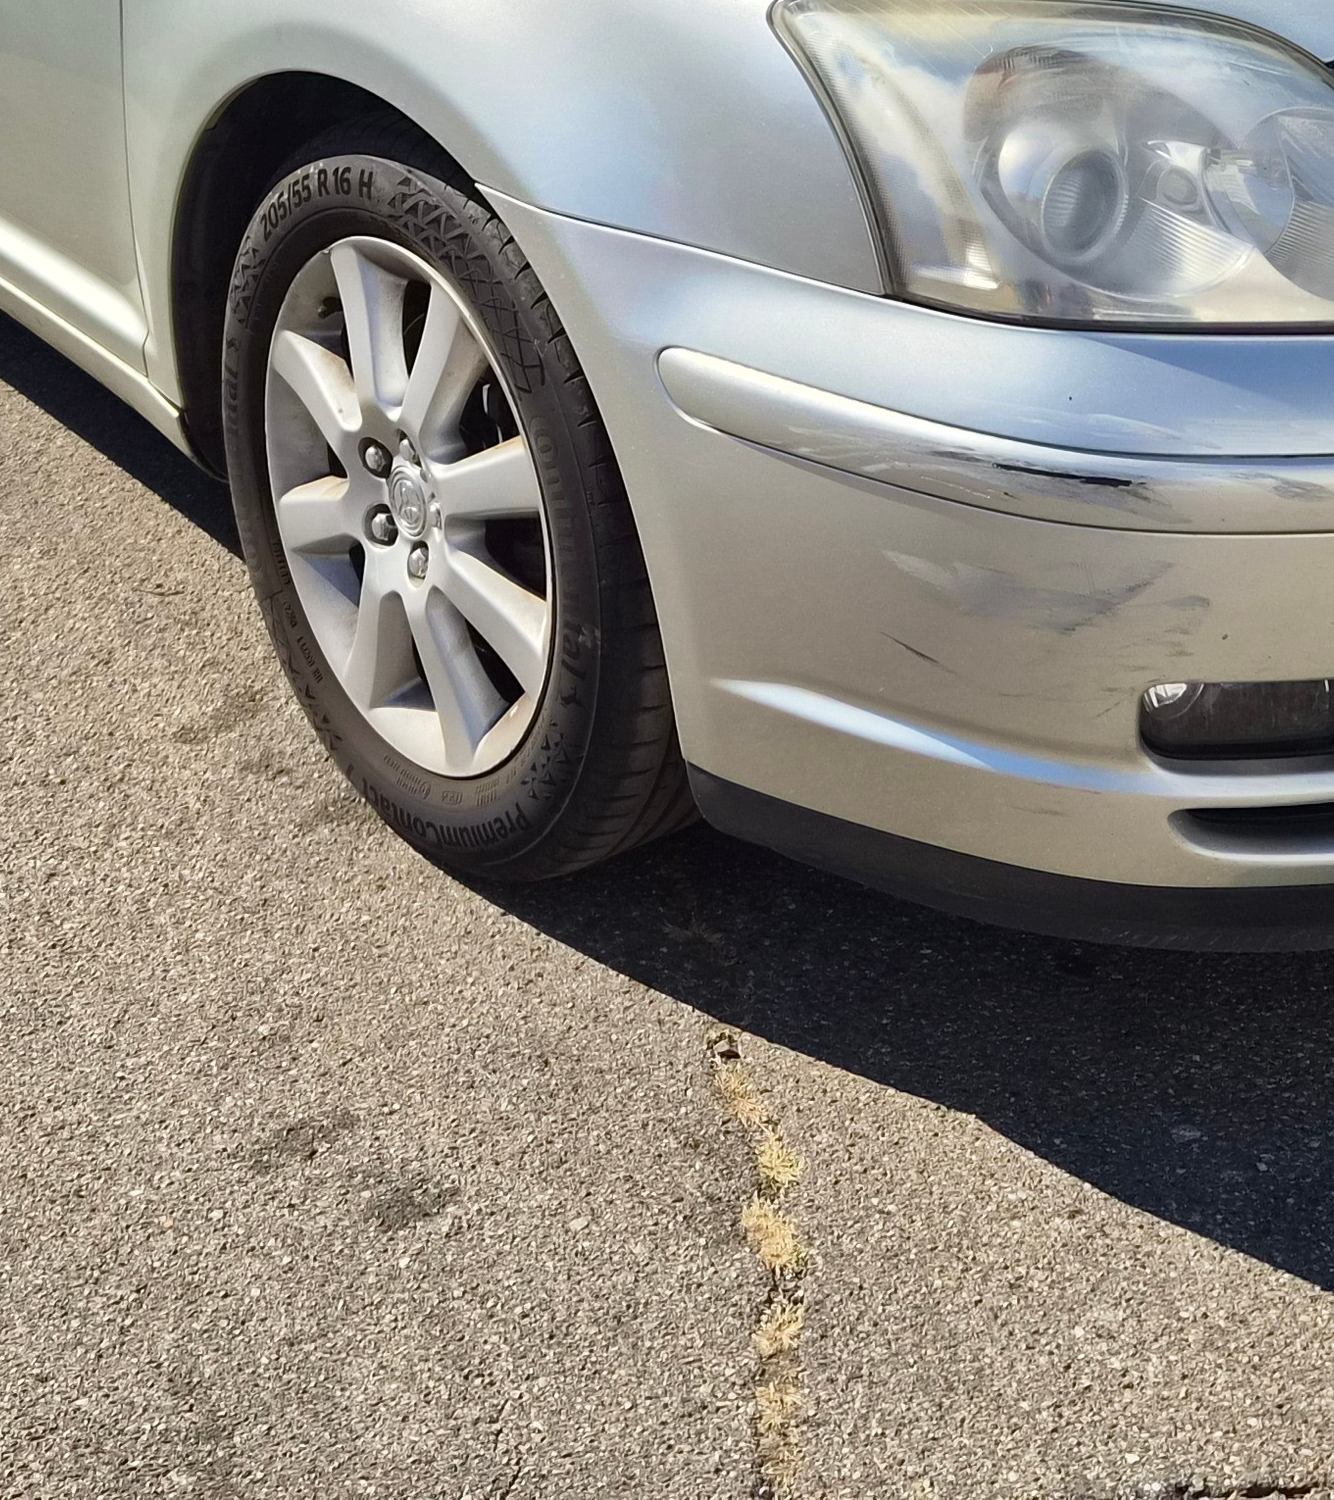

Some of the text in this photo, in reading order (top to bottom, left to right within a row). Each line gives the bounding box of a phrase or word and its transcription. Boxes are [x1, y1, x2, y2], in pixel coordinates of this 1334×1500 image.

[259, 166, 374, 242] 205/55 R 16 H
